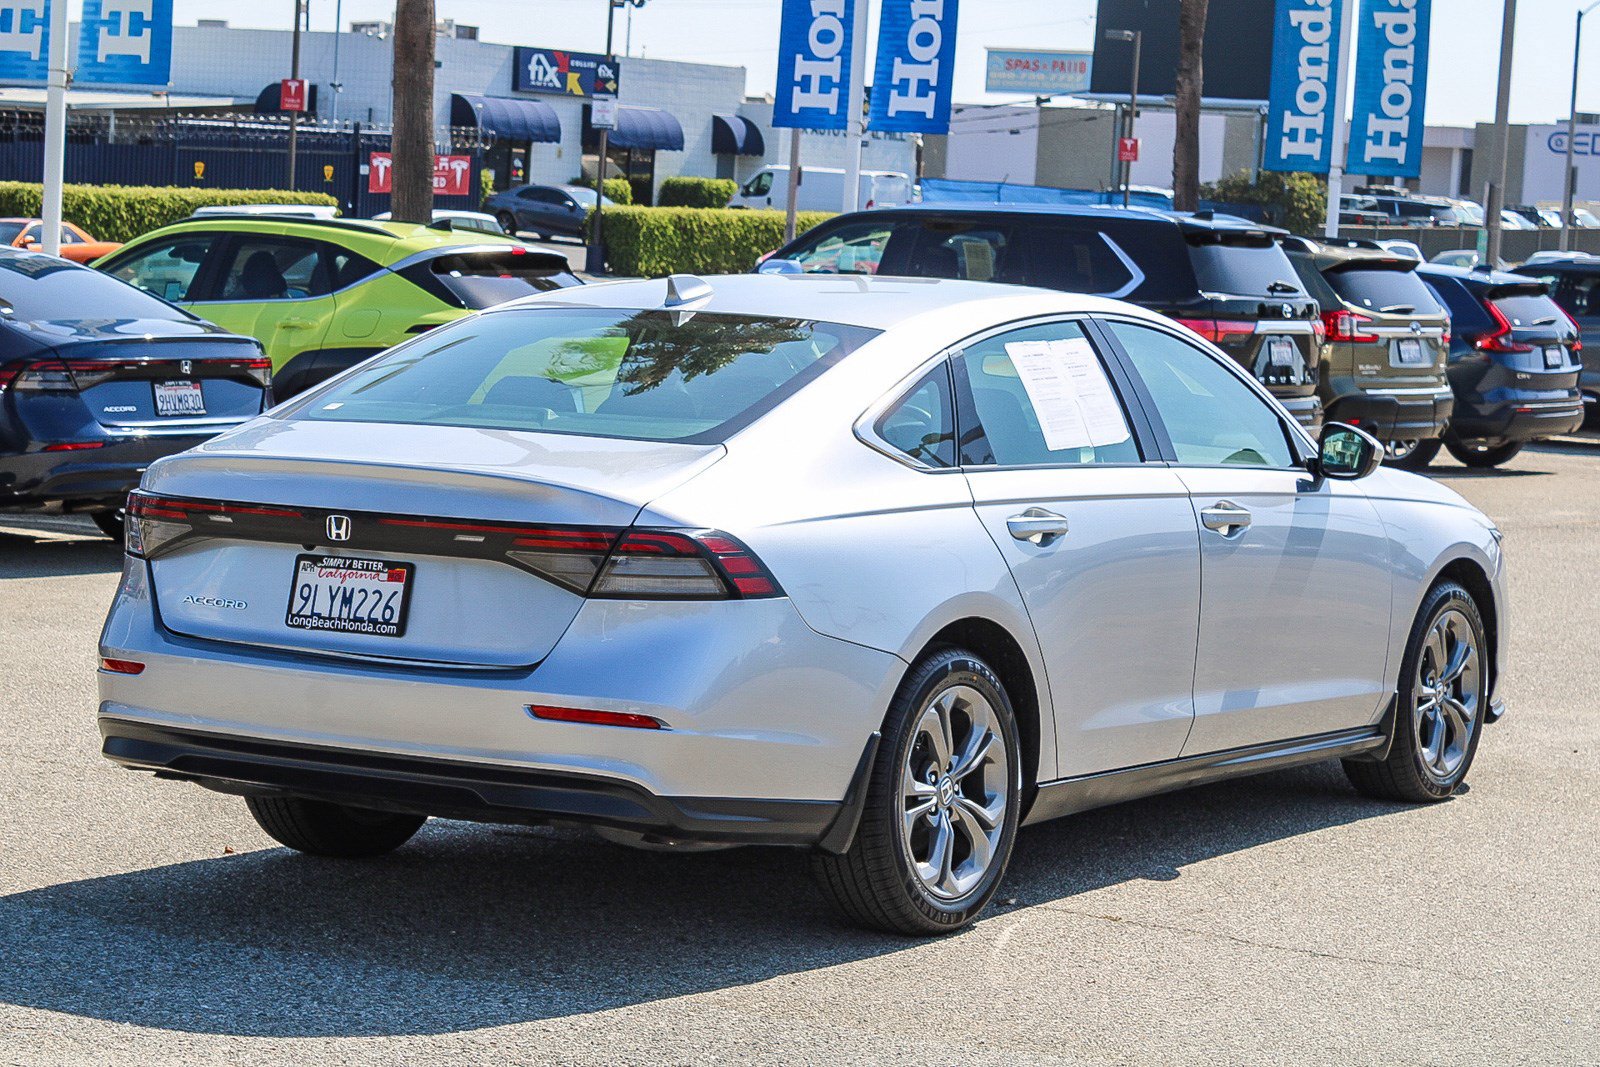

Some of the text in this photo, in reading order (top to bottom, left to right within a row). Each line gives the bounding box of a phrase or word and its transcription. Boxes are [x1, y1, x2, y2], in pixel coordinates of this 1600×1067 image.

[1005, 58, 1040, 72] SPAS
[1280, 0, 1333, 161] Hond
[1364, 0, 1417, 164] Hond
[321, 557, 384, 571] SIMPLY BETTER
[317, 566, 384, 584] California
[182, 594, 248, 610] ACCORD
[296, 582, 399, 623] 9LYM226
[287, 613, 397, 634] LongBeachHonda.com
